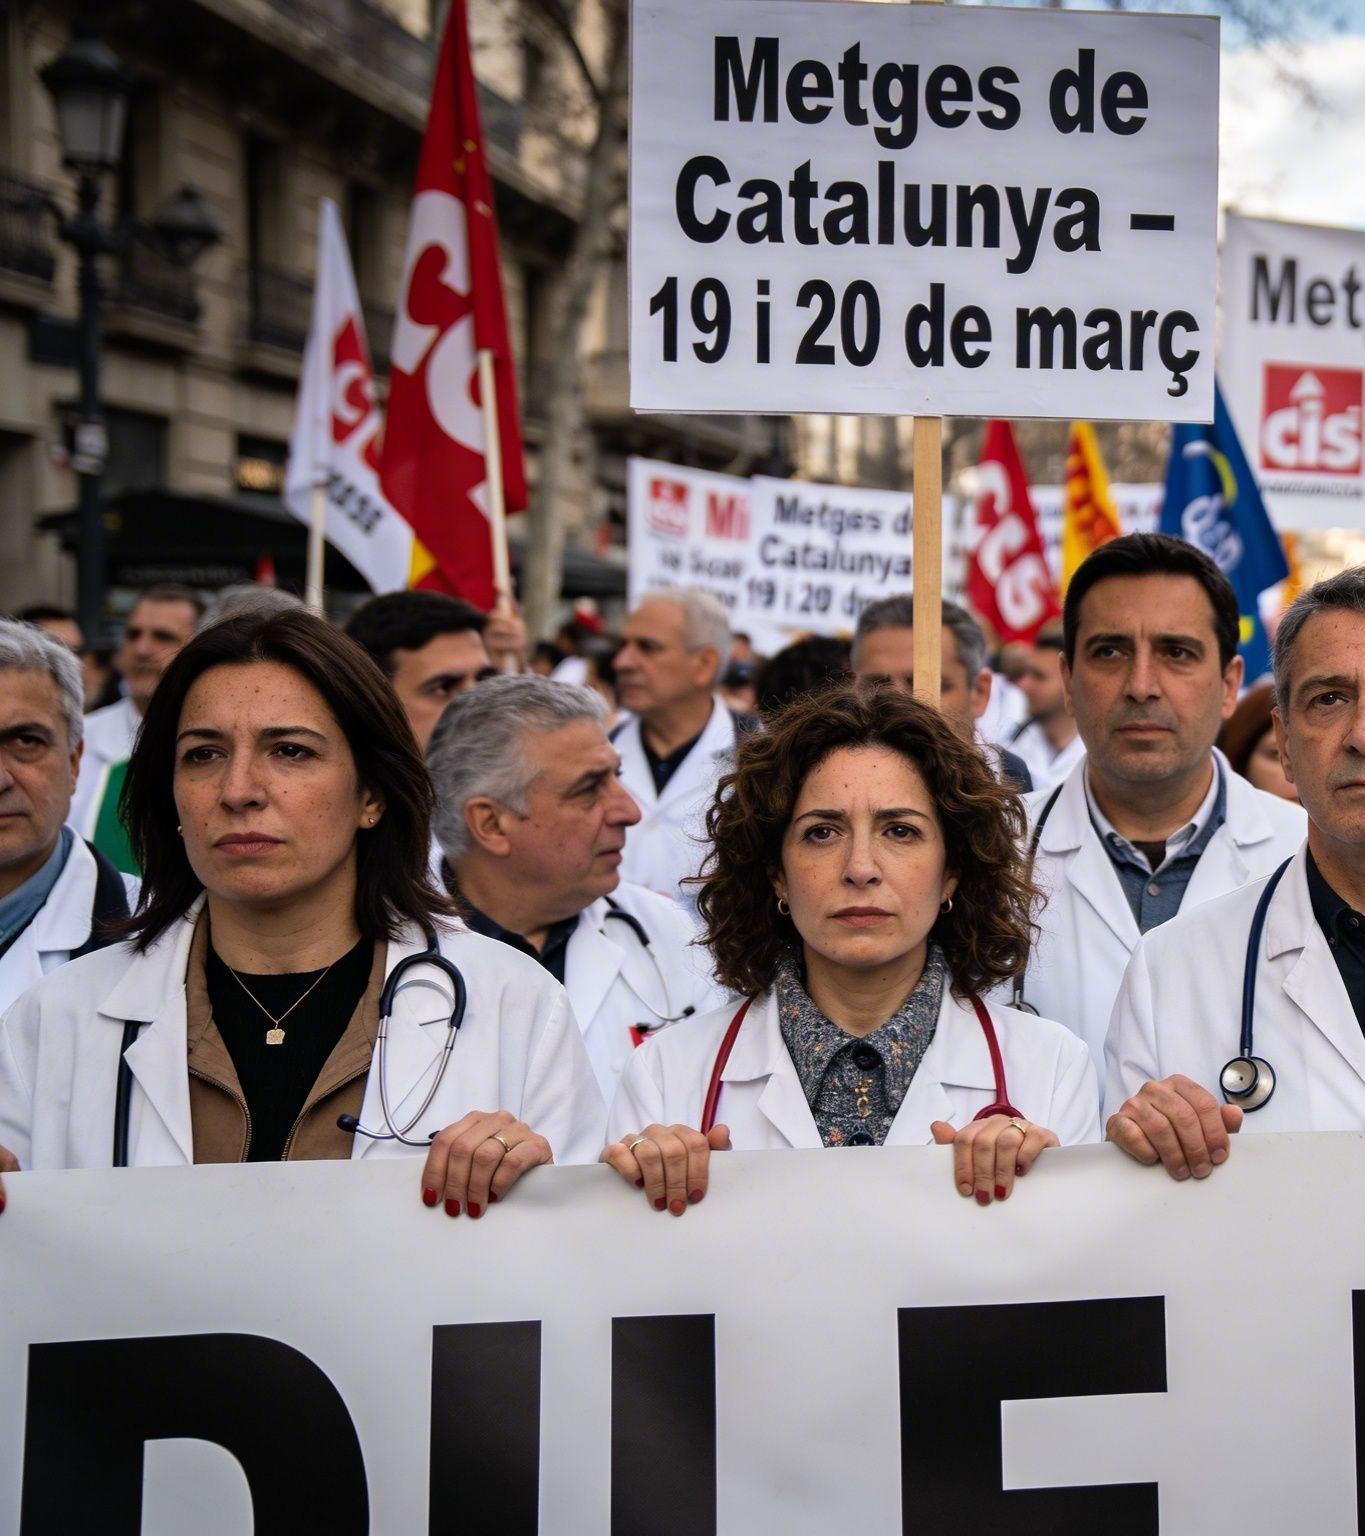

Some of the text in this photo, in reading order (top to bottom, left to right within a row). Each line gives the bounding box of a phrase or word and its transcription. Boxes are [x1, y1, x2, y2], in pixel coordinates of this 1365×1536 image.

[713, 35, 1149, 150] Metges de
[675, 154, 1102, 275] Catalunya
[649, 276, 1200, 398] 19 i 20 de març
[759, 533, 913, 583] Catalunya
[772, 494, 913, 536] Metges d
